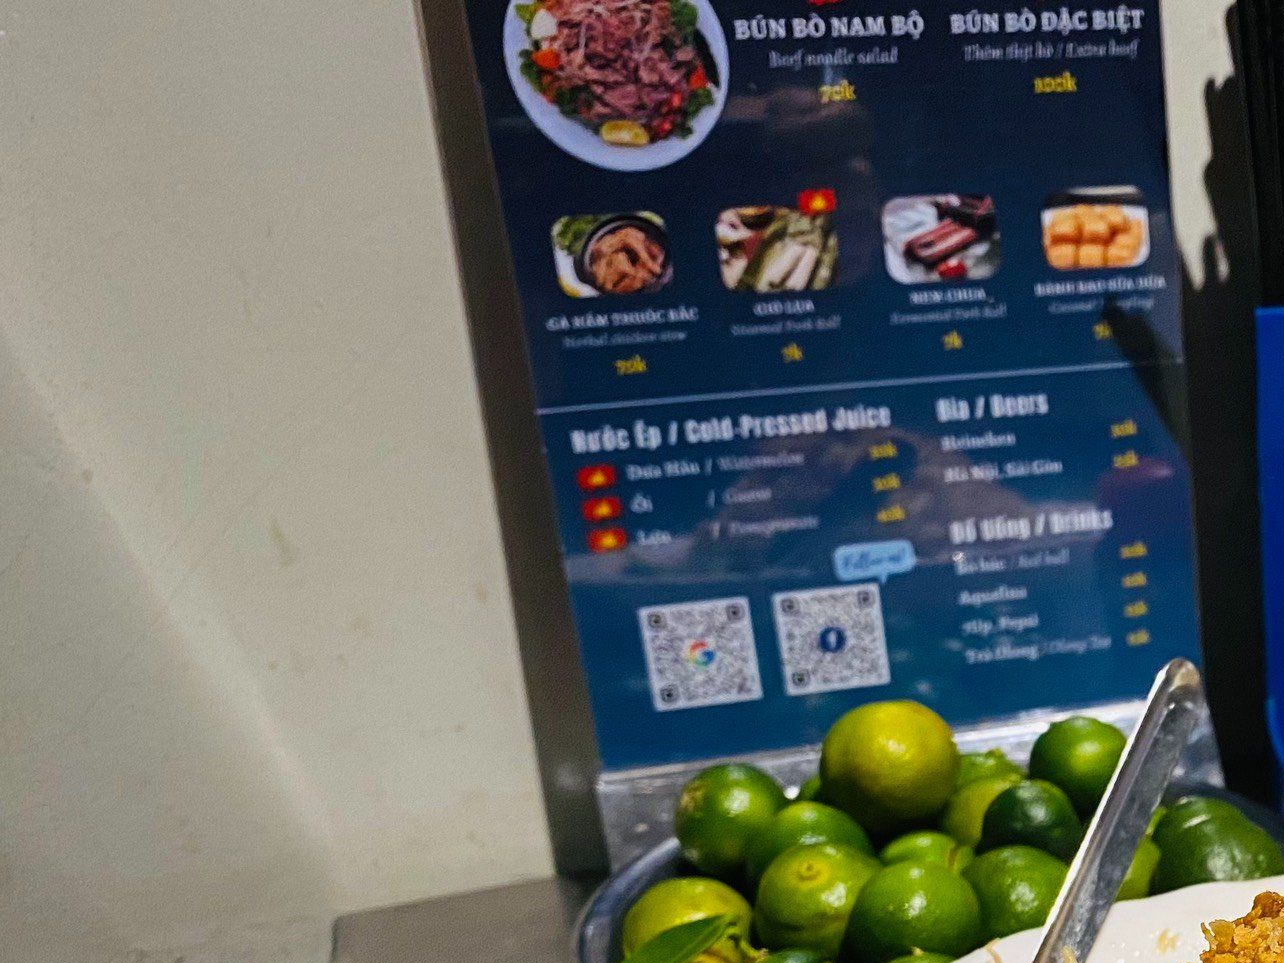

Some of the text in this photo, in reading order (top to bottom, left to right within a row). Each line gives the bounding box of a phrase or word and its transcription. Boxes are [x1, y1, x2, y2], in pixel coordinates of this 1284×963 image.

[734, 9, 925, 40] BÚN BÒ NAM BỘ
[950, 4, 1145, 35] BÚN BÒ ĐẶC BIỆT
[570, 423, 631, 455] Nước
[634, 418, 663, 451] Ép
[684, 408, 828, 444] Cold-Pressed
[832, 404, 892, 432] Juice
